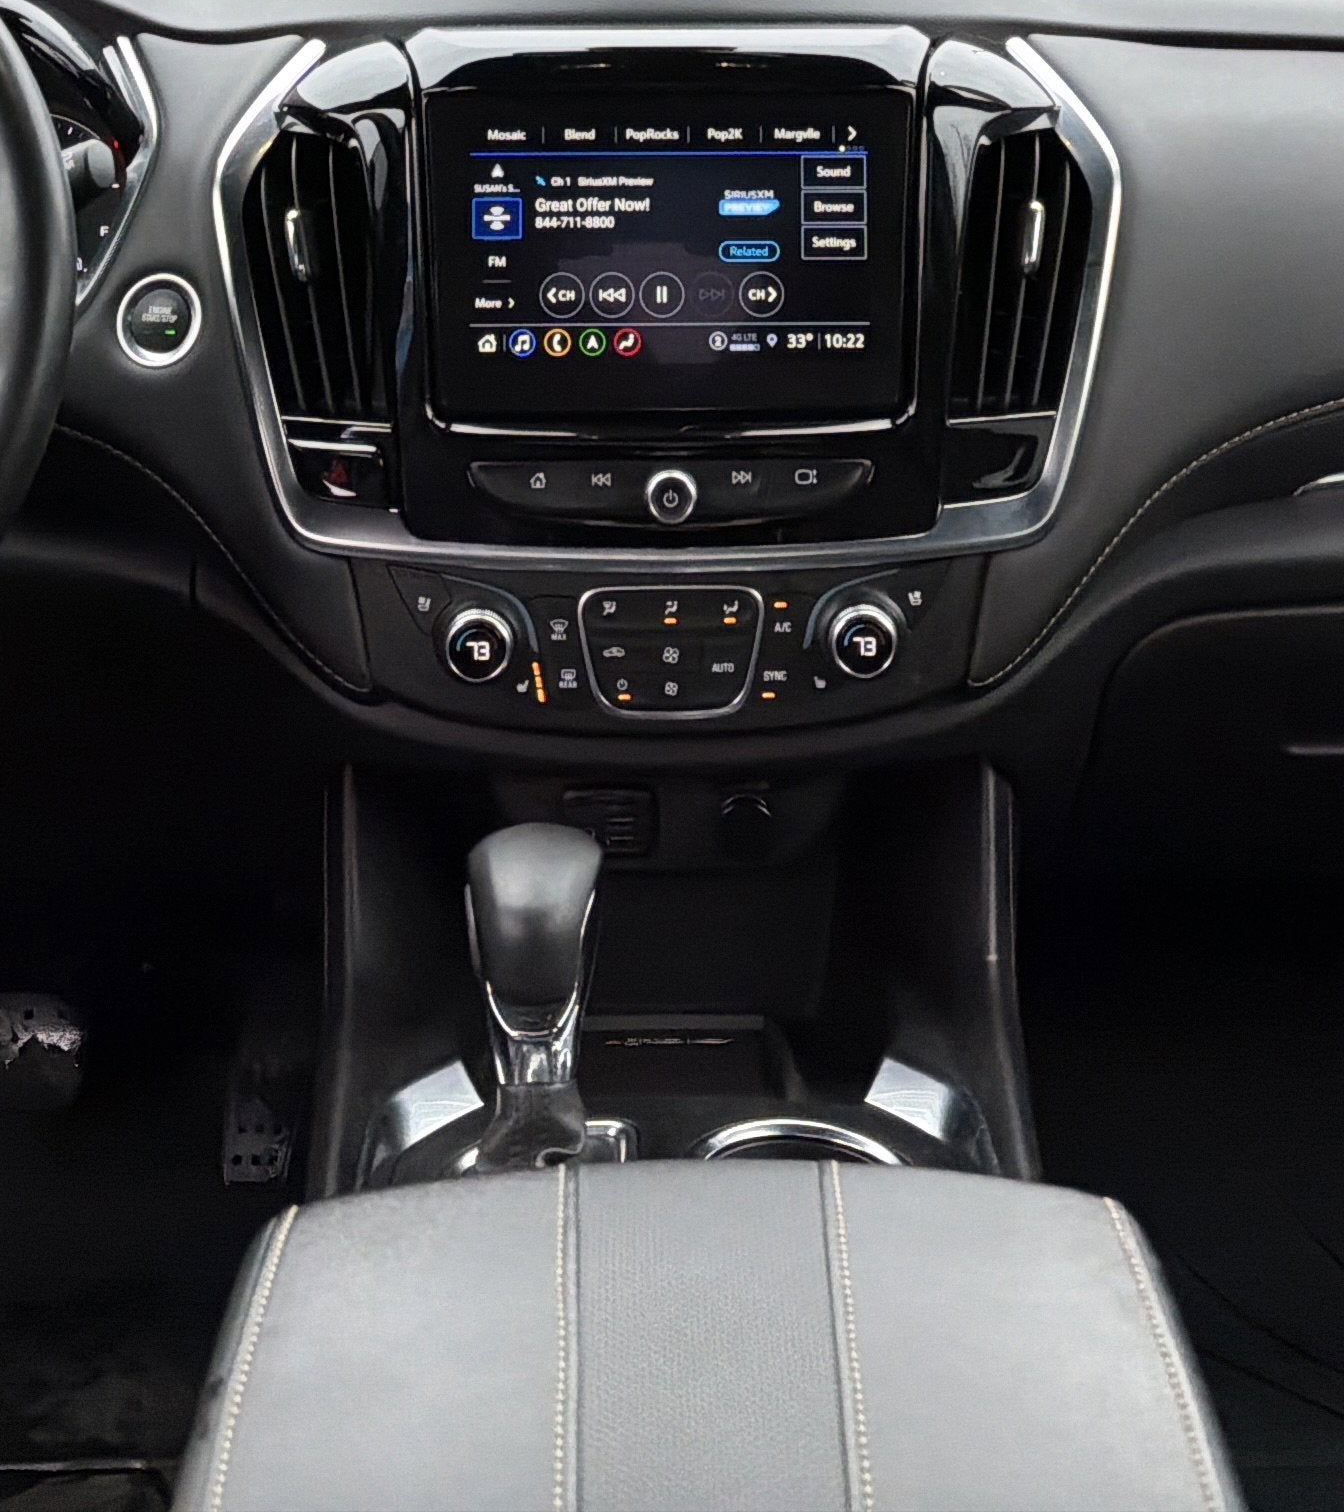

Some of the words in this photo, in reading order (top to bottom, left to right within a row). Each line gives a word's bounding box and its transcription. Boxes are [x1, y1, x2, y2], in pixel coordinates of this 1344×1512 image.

[487, 129, 527, 141] Mosaic
[564, 128, 596, 140] Blend
[625, 128, 680, 142] PopRocks
[707, 128, 743, 141] Pop2K
[816, 165, 851, 178] Sound
[577, 176, 617, 186] SiriusXM
[618, 176, 654, 186] Preview
[535, 198, 573, 212] Great
[576, 198, 611, 212] Offer
[614, 198, 650, 212] Now!
[814, 201, 854, 213] Browse
[535, 216, 615, 229] 844-711-8800
[812, 236, 857, 251] Settings
[729, 246, 769, 257] Related
[488, 256, 507, 268] FM
[558, 290, 576, 302] CH
[748, 289, 765, 301] CH
[475, 297, 503, 309] More
[825, 333, 865, 349] 10:22
[774, 622, 792, 633] A/C
[466, 641, 491, 661] 73
[853, 636, 877, 657] 73
[711, 663, 735, 673] AUTO
[763, 671, 787, 682] SYNC
